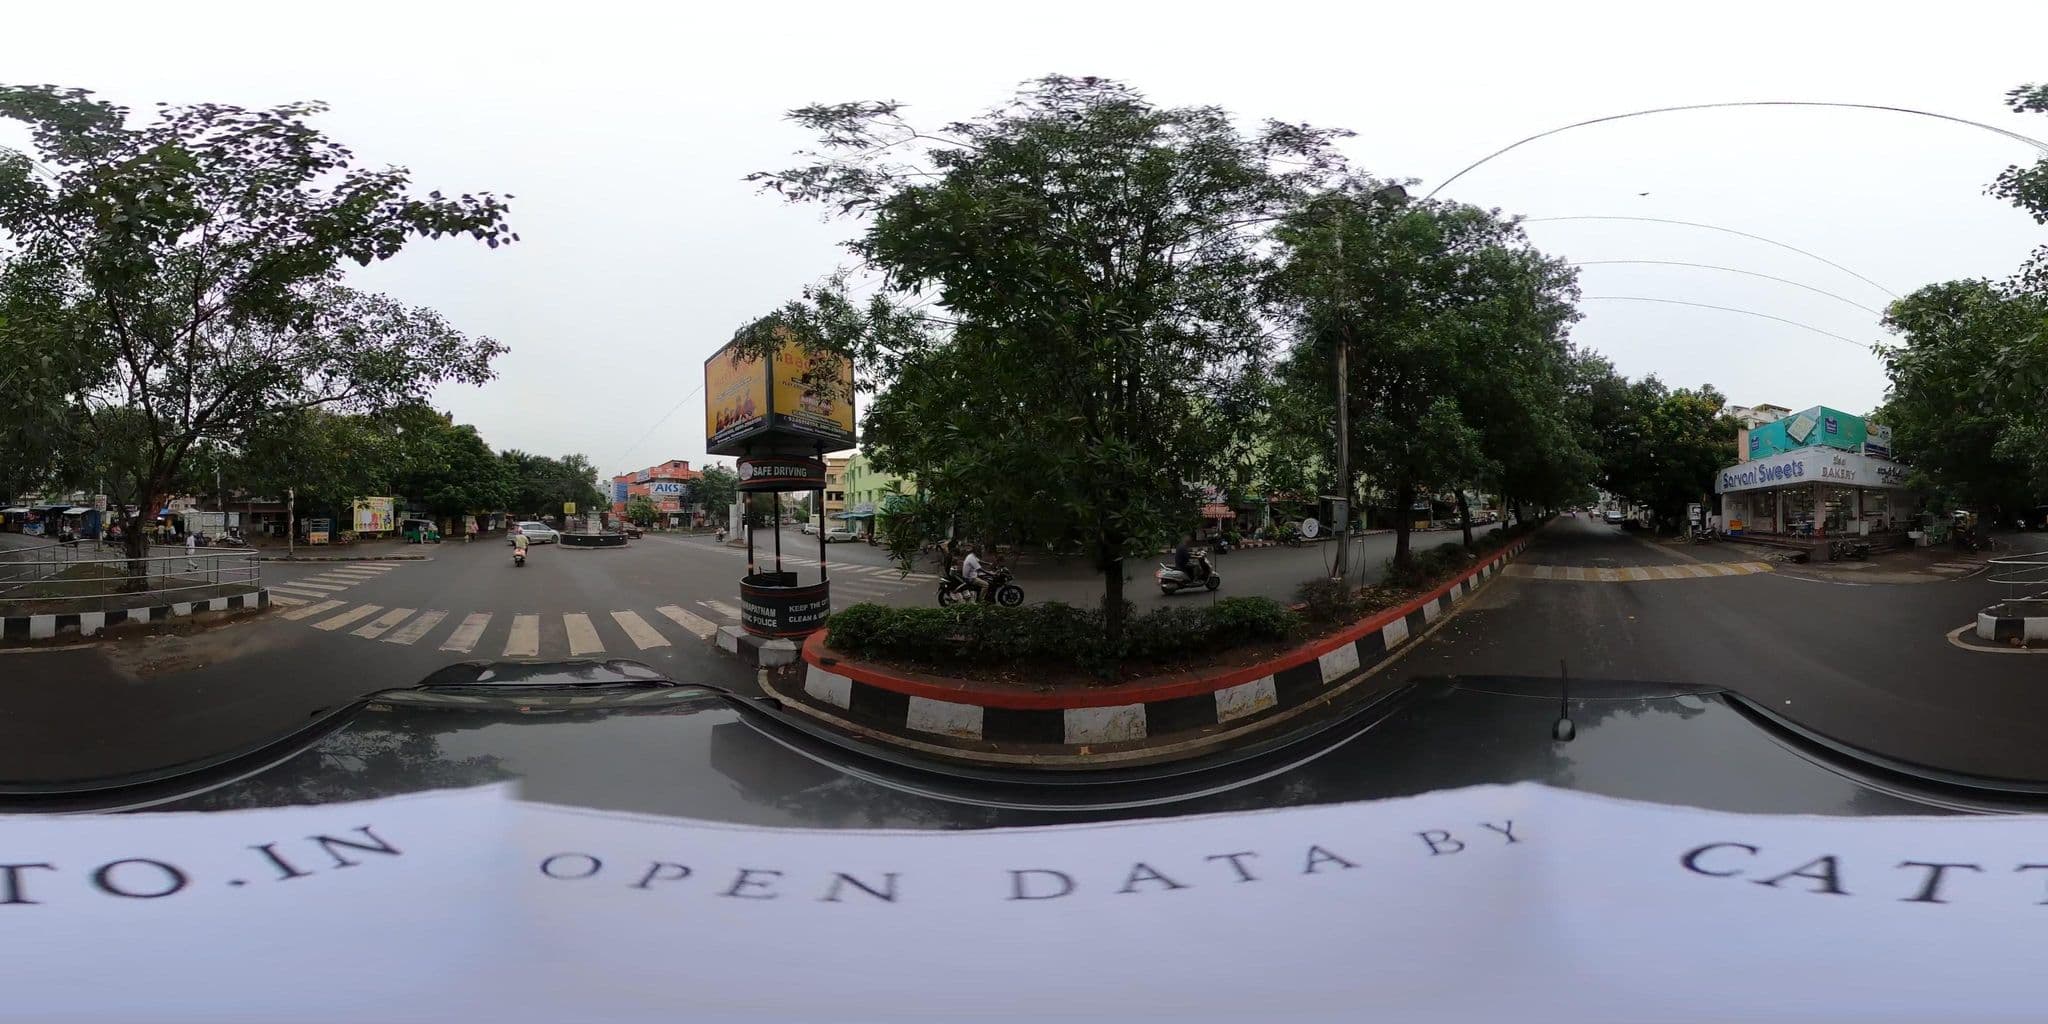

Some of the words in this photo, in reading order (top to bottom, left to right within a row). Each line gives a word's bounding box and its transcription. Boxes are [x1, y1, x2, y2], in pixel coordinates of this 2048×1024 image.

[753, 466, 773, 477] SAFE
[774, 466, 807, 477] DRIVING
[1723, 465, 1758, 488] Sarvani
[1758, 460, 1805, 482] Sweets
[1821, 466, 1856, 480] BAKERY
[654, 483, 680, 493] AKS
[788, 604, 808, 613] KEEP
[753, 616, 777, 628] POLICE
[788, 615, 812, 623] CLEAN
[538, 851, 903, 903] OPEN
[1007, 843, 1362, 902] DATA
[1415, 819, 1524, 857] BY
